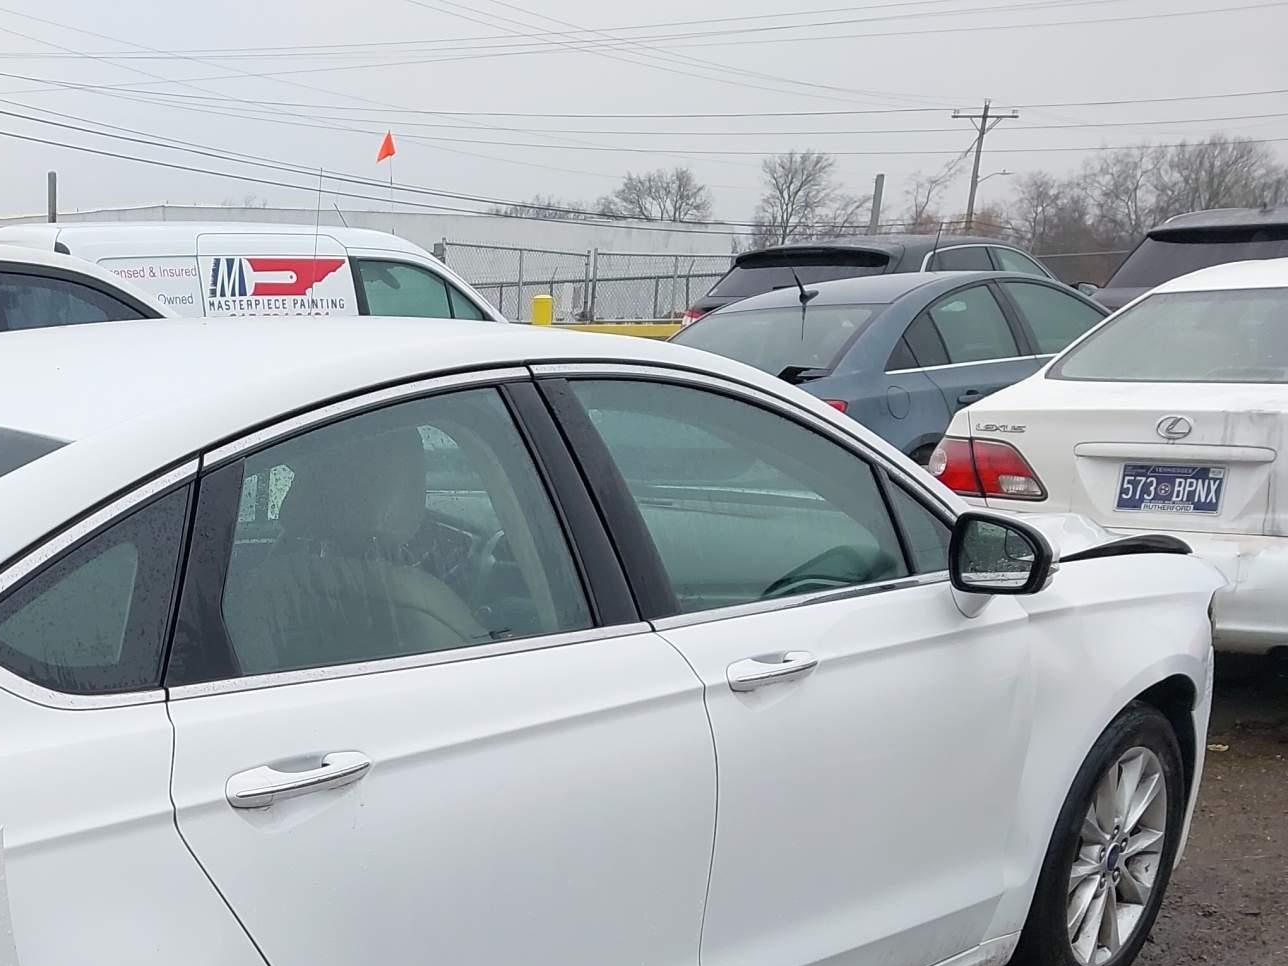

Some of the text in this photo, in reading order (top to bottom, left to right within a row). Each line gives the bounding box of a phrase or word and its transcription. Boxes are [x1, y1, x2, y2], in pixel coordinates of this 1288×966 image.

[148, 266, 157, 278] &
[159, 265, 198, 278] Insured
[208, 298, 346, 312] MASTERPIECE PAINTING
[1121, 475, 1221, 504] 573 BPNX
[1143, 503, 1192, 512] RUTHERFORD
